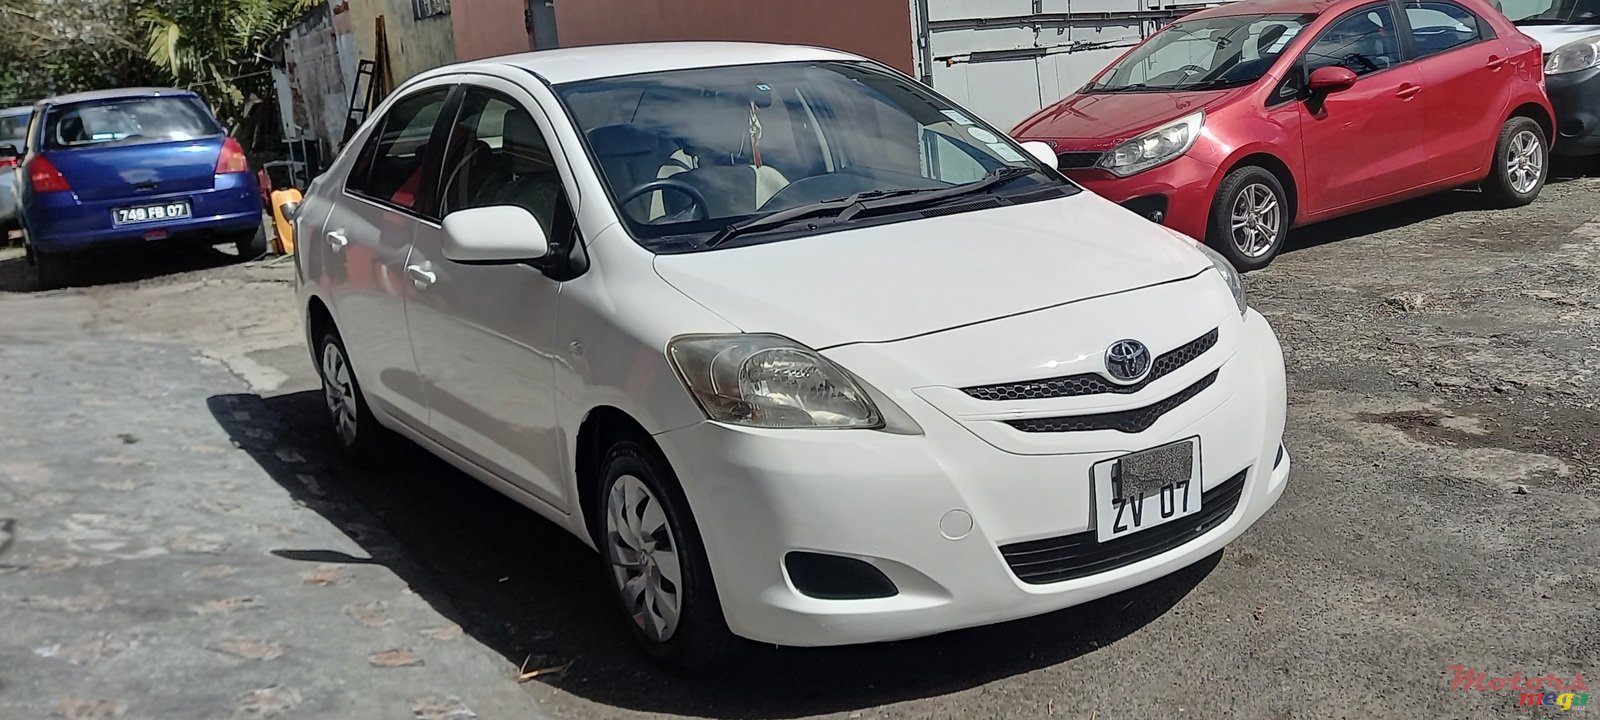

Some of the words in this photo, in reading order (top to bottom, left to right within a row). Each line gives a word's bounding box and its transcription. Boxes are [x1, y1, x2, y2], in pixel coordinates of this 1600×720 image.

[148, 206, 166, 219] FB
[166, 204, 184, 218] 07
[1112, 493, 1144, 534] ZV
[1160, 480, 1189, 518] 07
